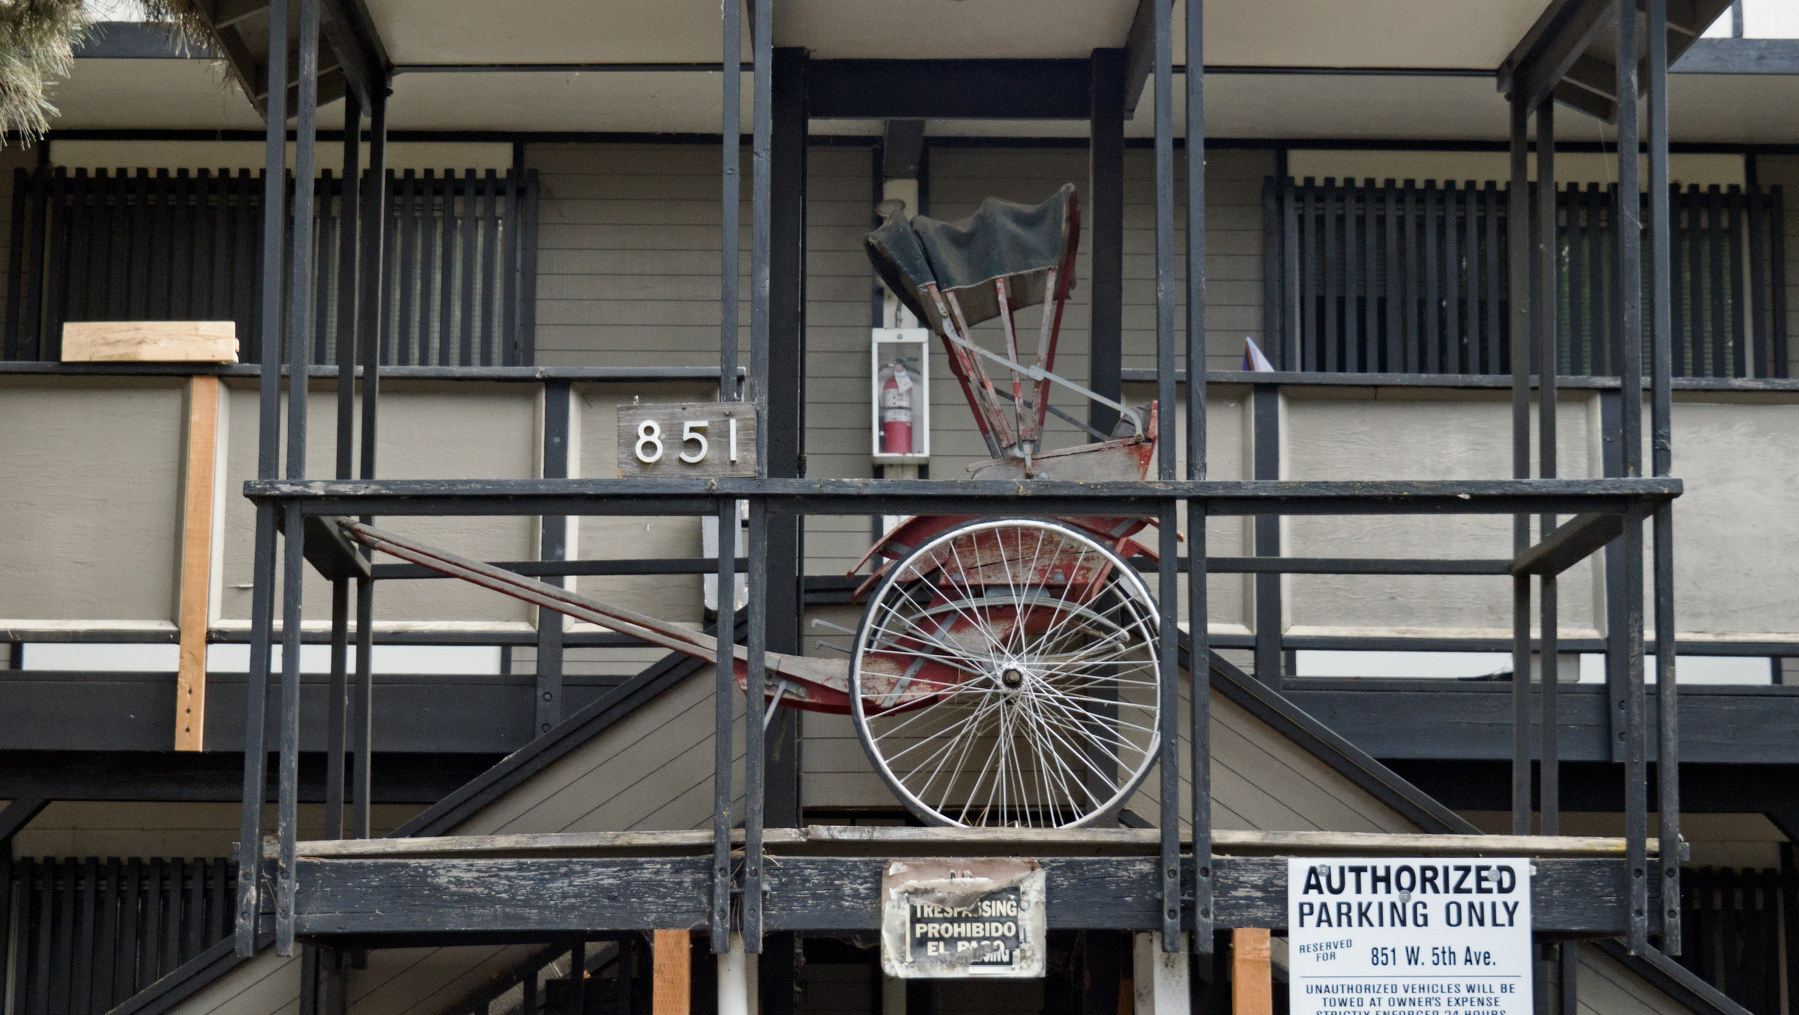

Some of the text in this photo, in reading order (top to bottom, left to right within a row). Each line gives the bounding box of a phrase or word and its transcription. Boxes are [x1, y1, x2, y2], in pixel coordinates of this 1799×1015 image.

[635, 418, 737, 463] 851
[1302, 864, 1517, 895] AUTHORIZED
[916, 900, 1018, 918] TRESPSING
[1298, 901, 1519, 928] PARKING ONLY
[915, 922, 1016, 938] PROHIBIDO
[927, 940, 1006, 956] EL PO
[1299, 938, 1353, 954] RESERVED
[1316, 951, 1337, 962] FOR
[1371, 945, 1497, 966] 851 W. 5th Ave.
[1305, 983, 1515, 994] UNAUTHORIZED VEHICLES WILL BE
[1321, 996, 1500, 1007] TOWED AT OWNER'S EXPENSE
